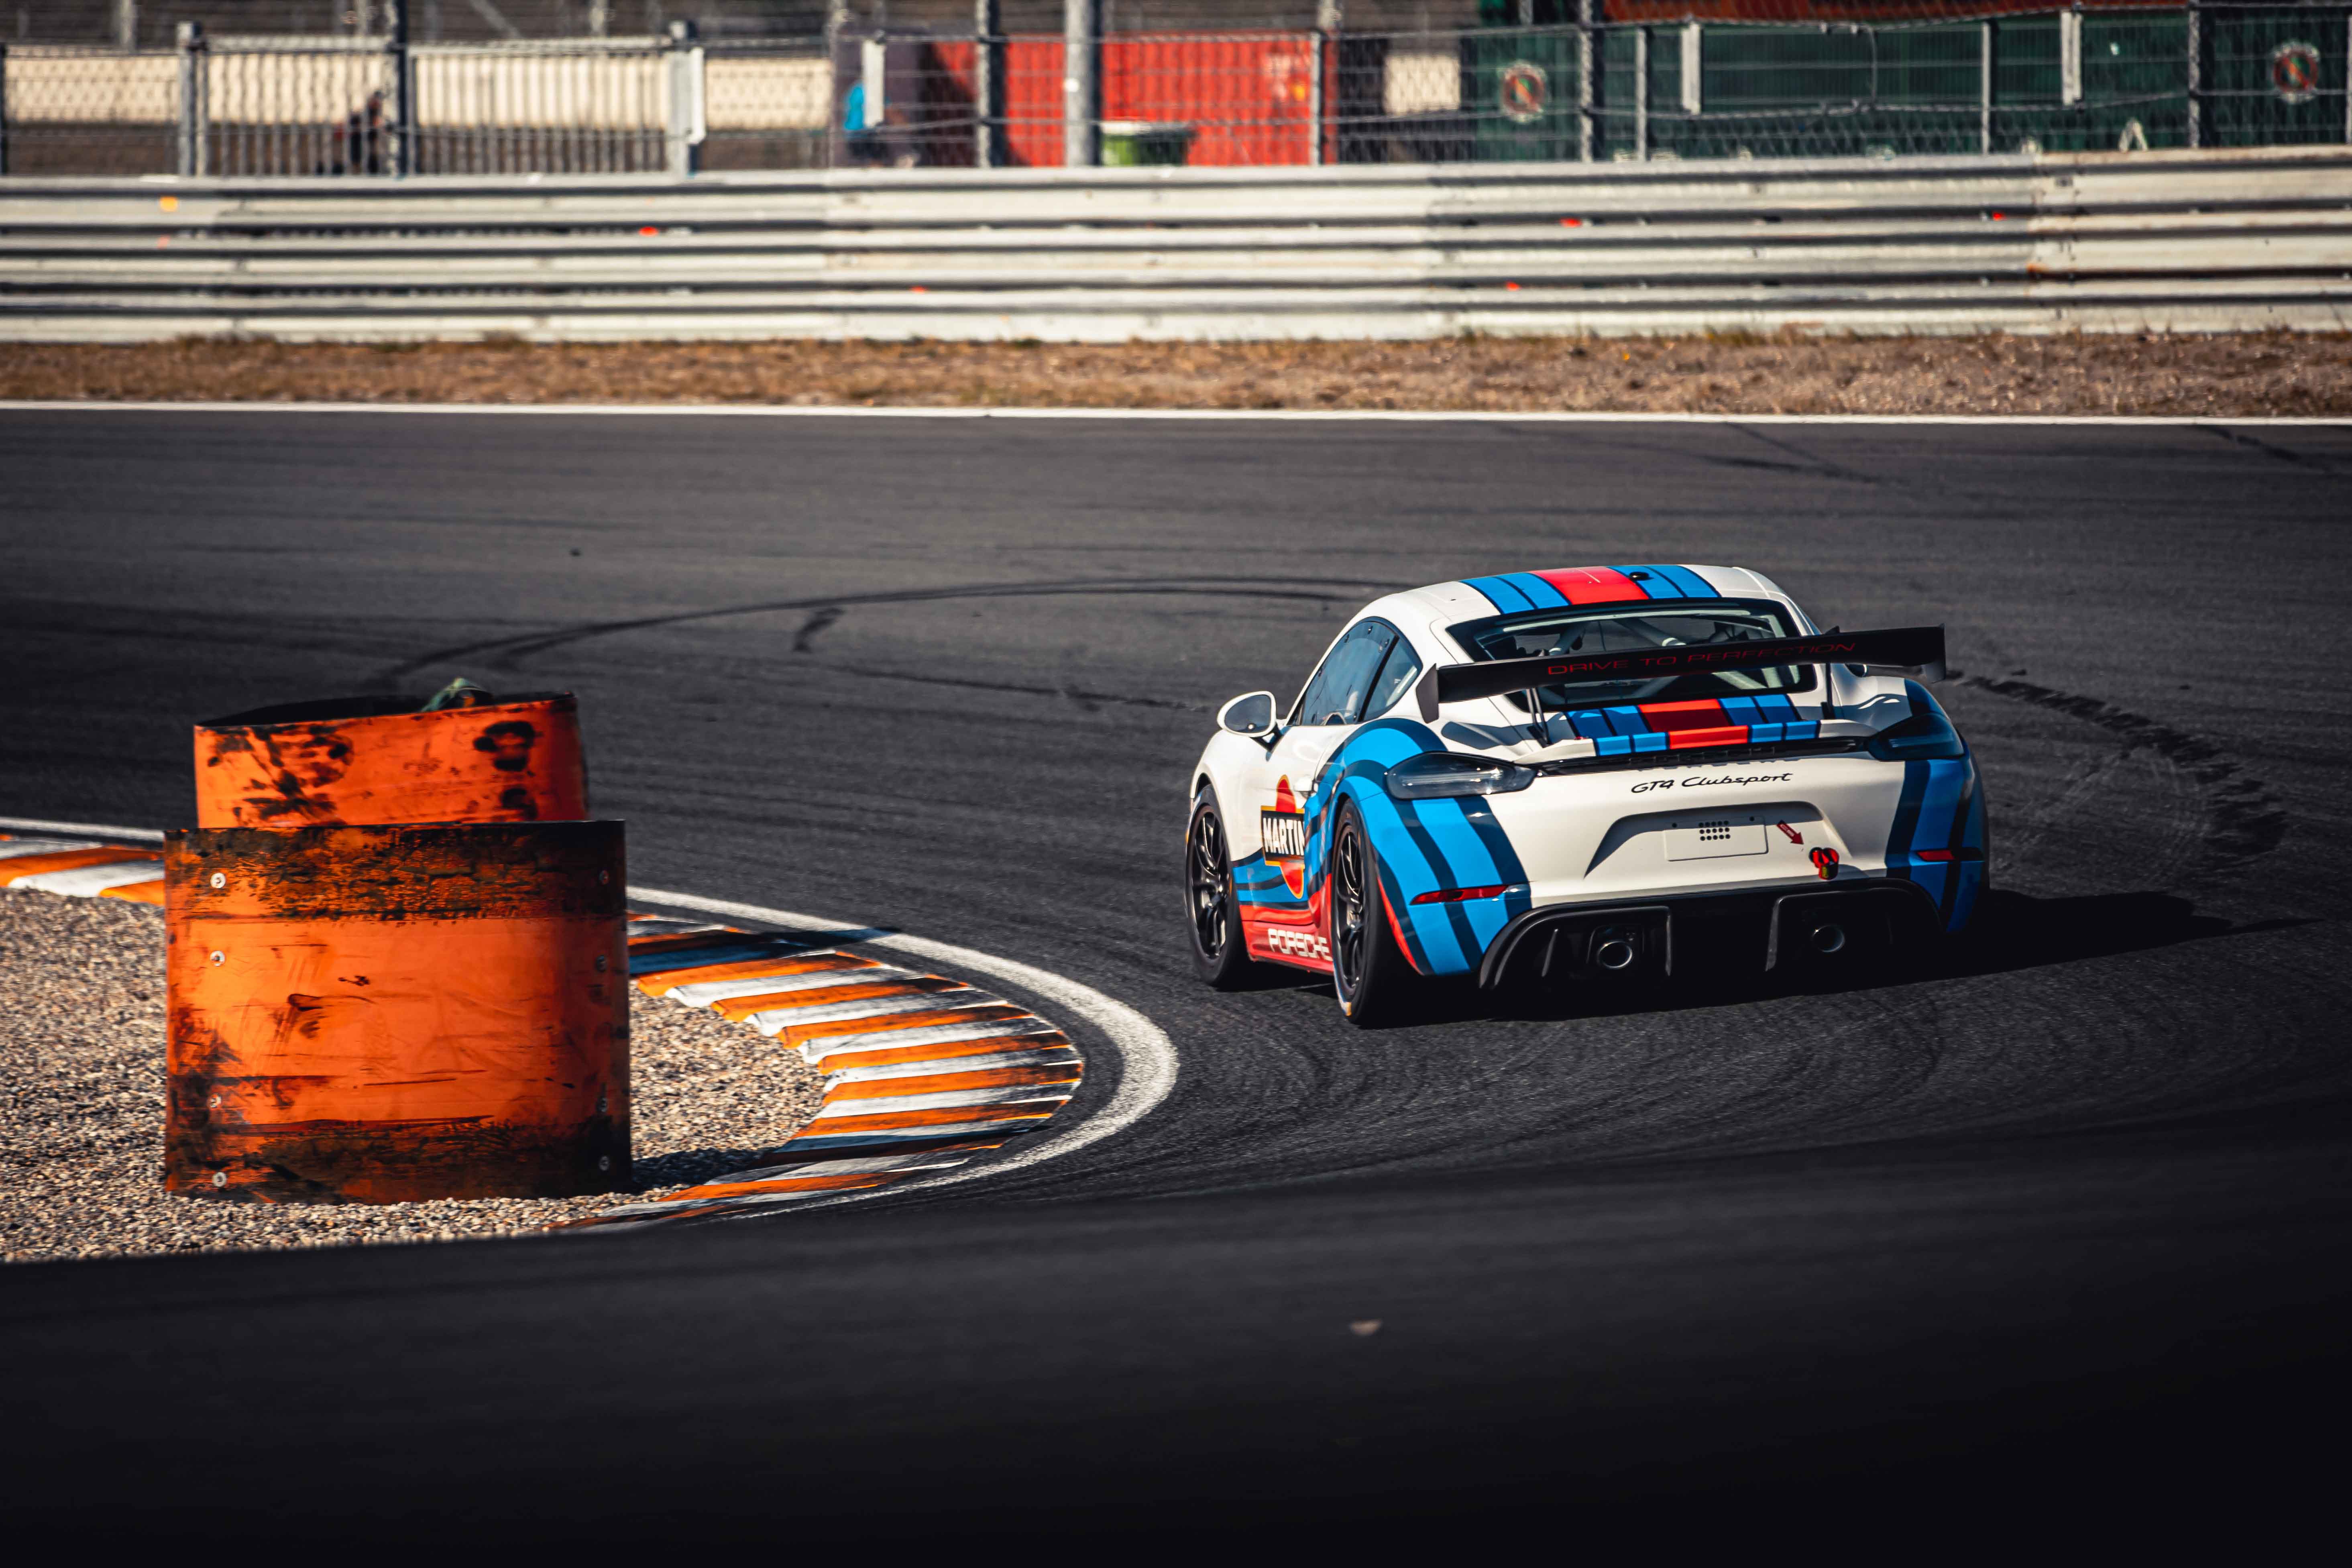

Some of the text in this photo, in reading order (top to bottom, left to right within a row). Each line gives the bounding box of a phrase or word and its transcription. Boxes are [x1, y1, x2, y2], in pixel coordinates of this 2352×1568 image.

[1548, 643, 1856, 675] DRIVE TO PERFECTION
[1631, 773, 1794, 793] GT4 Clubsport
[1268, 928, 1333, 961] PORSCHE
